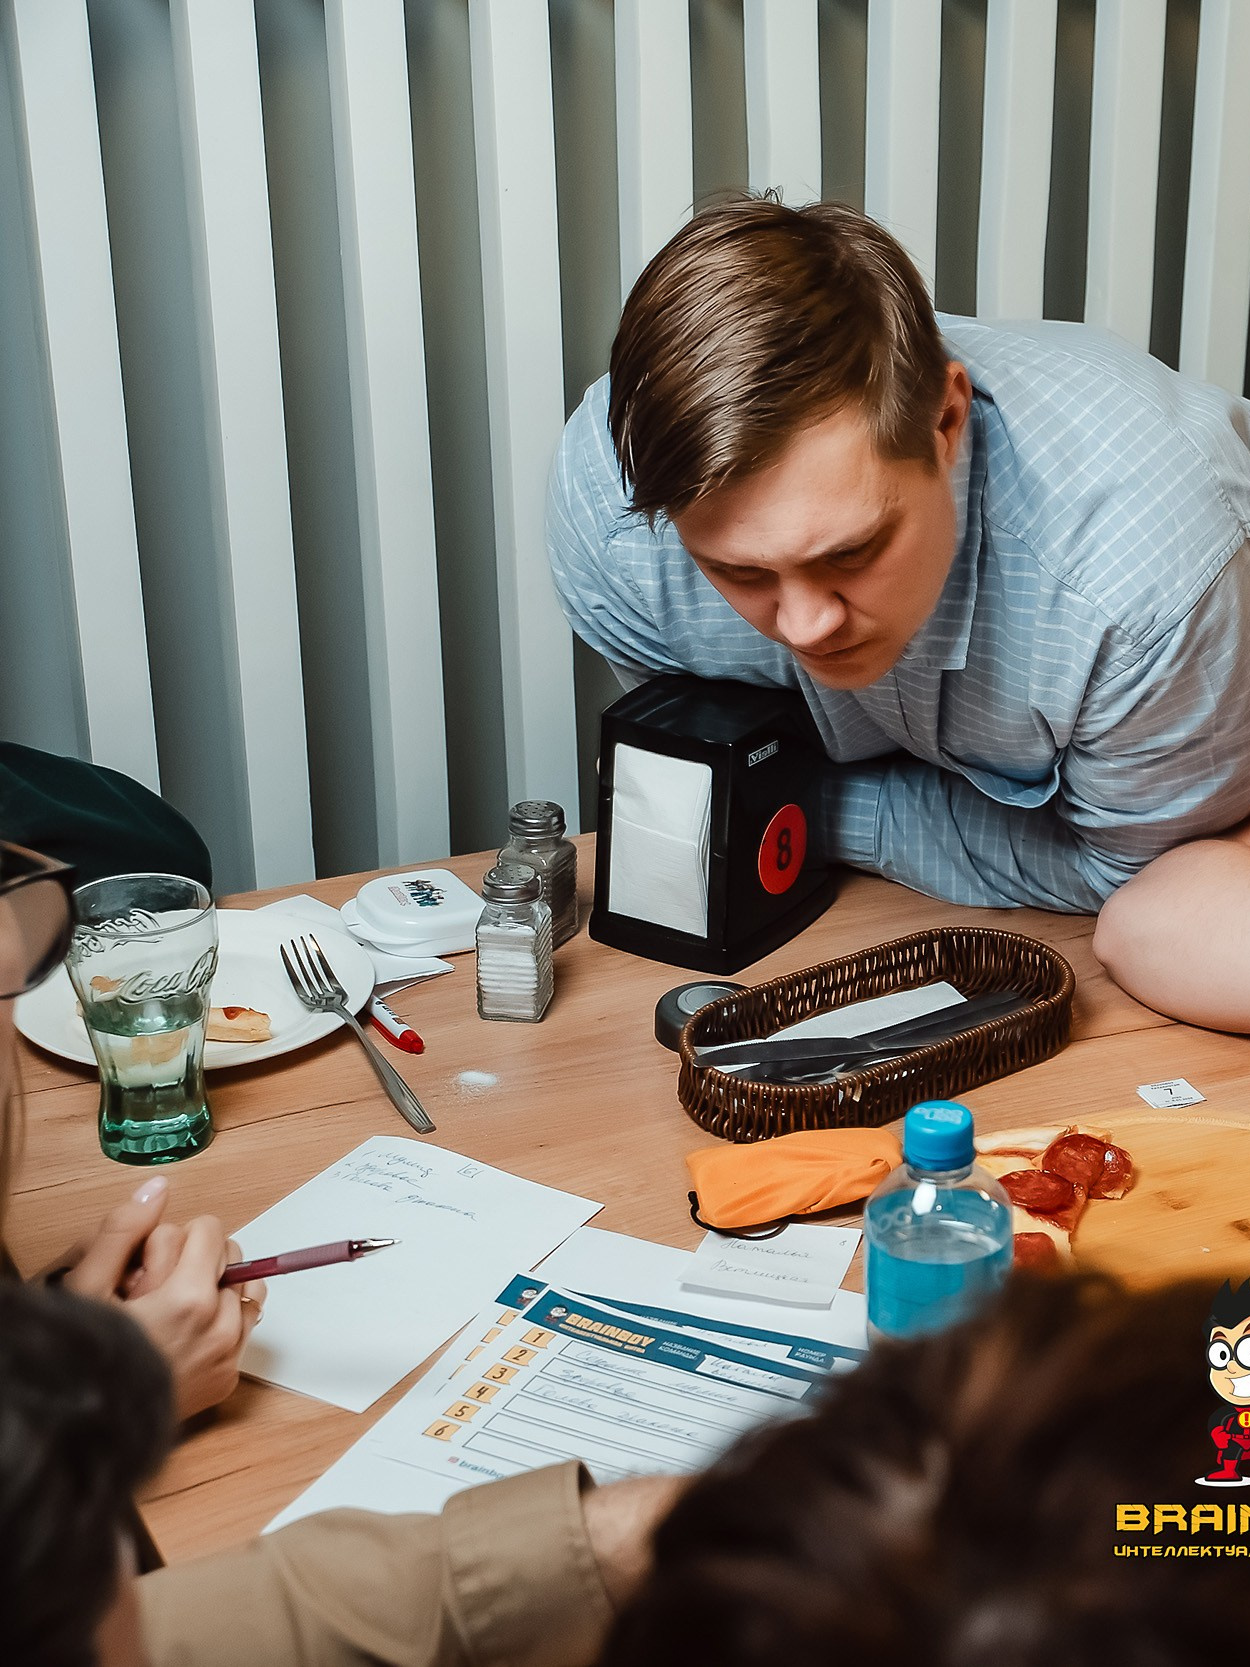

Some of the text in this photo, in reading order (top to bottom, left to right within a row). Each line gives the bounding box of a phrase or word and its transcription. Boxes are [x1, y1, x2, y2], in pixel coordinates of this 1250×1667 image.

[776, 827, 792, 872] 8
[565, 1313, 656, 1347] BRAINBOY
[535, 1331, 545, 1344] 1
[512, 1349, 527, 1361] 2
[492, 1367, 507, 1380] 3
[476, 1386, 490, 1399] 4
[454, 1405, 469, 1418] 5
[434, 1424, 450, 1437] 6
